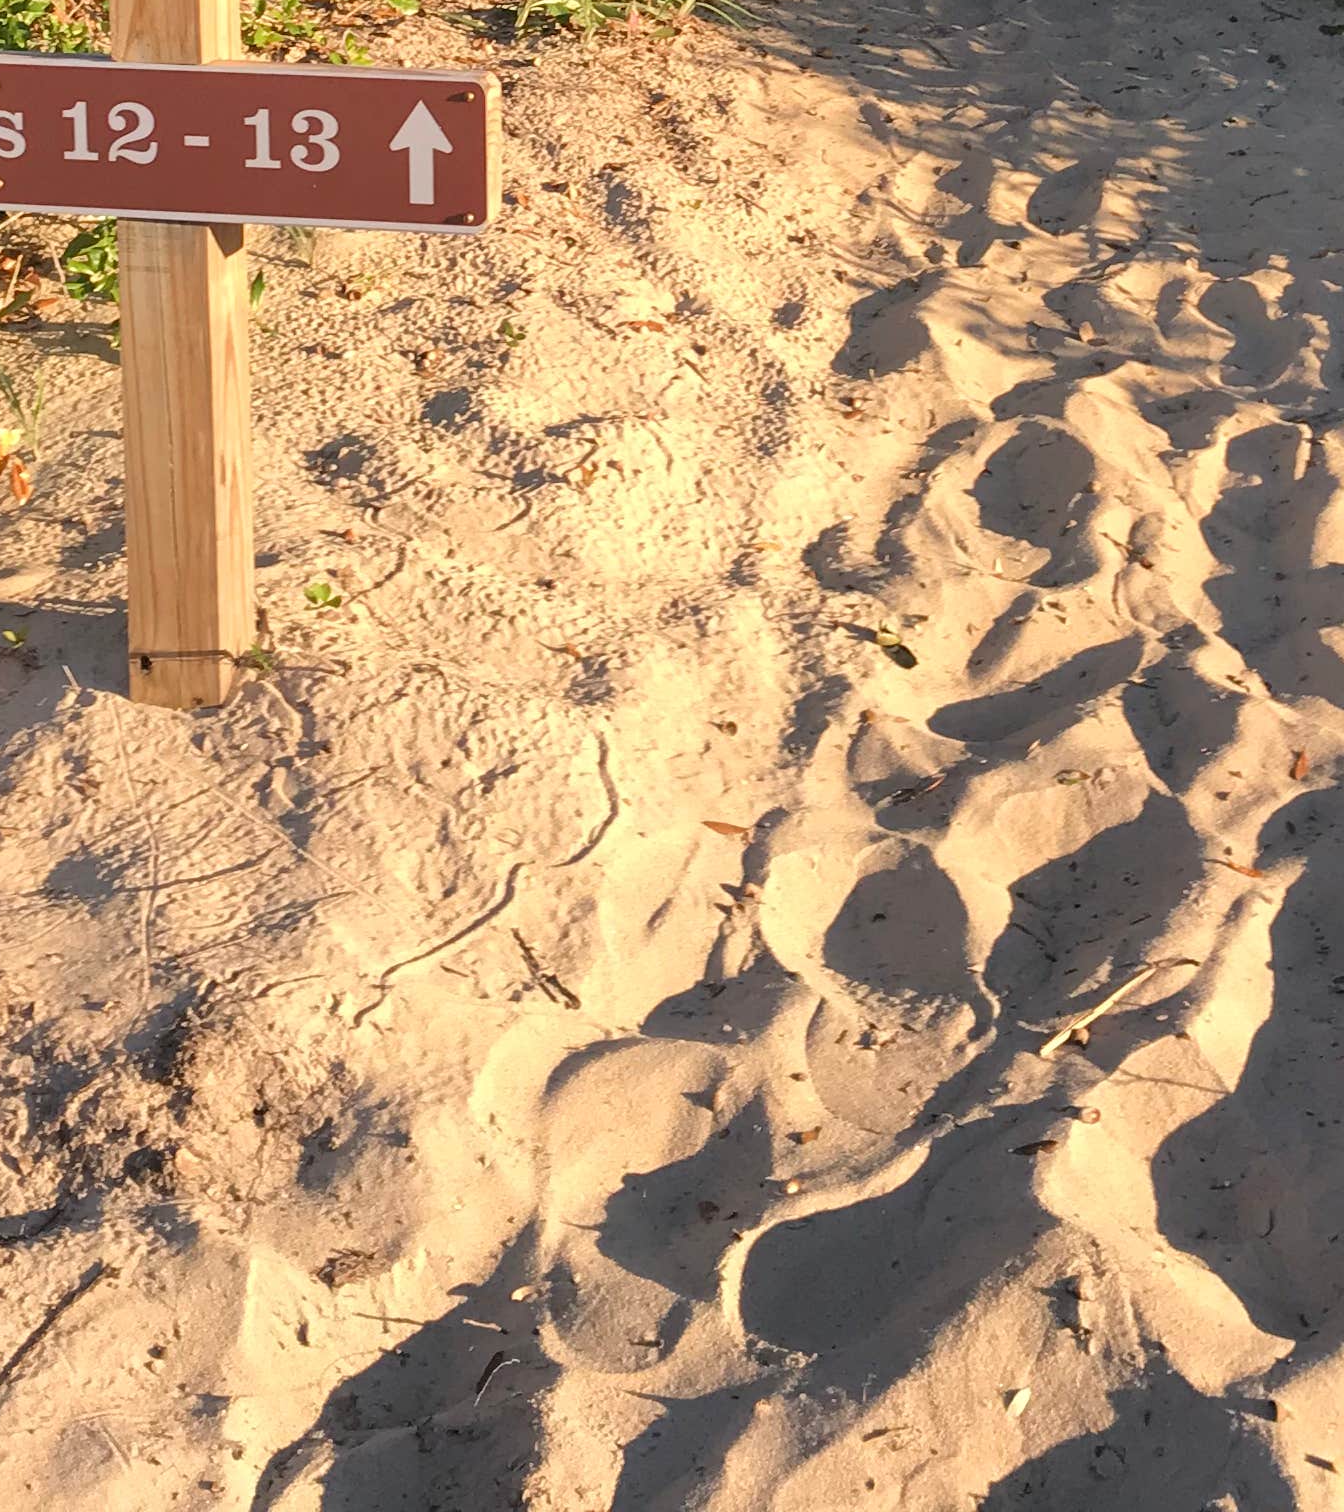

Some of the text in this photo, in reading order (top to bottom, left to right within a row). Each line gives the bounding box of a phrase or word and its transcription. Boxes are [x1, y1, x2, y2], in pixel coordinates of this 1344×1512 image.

[62, 101, 158, 165] 12
[182, 134, 211, 148] -
[243, 108, 340, 172] 13
